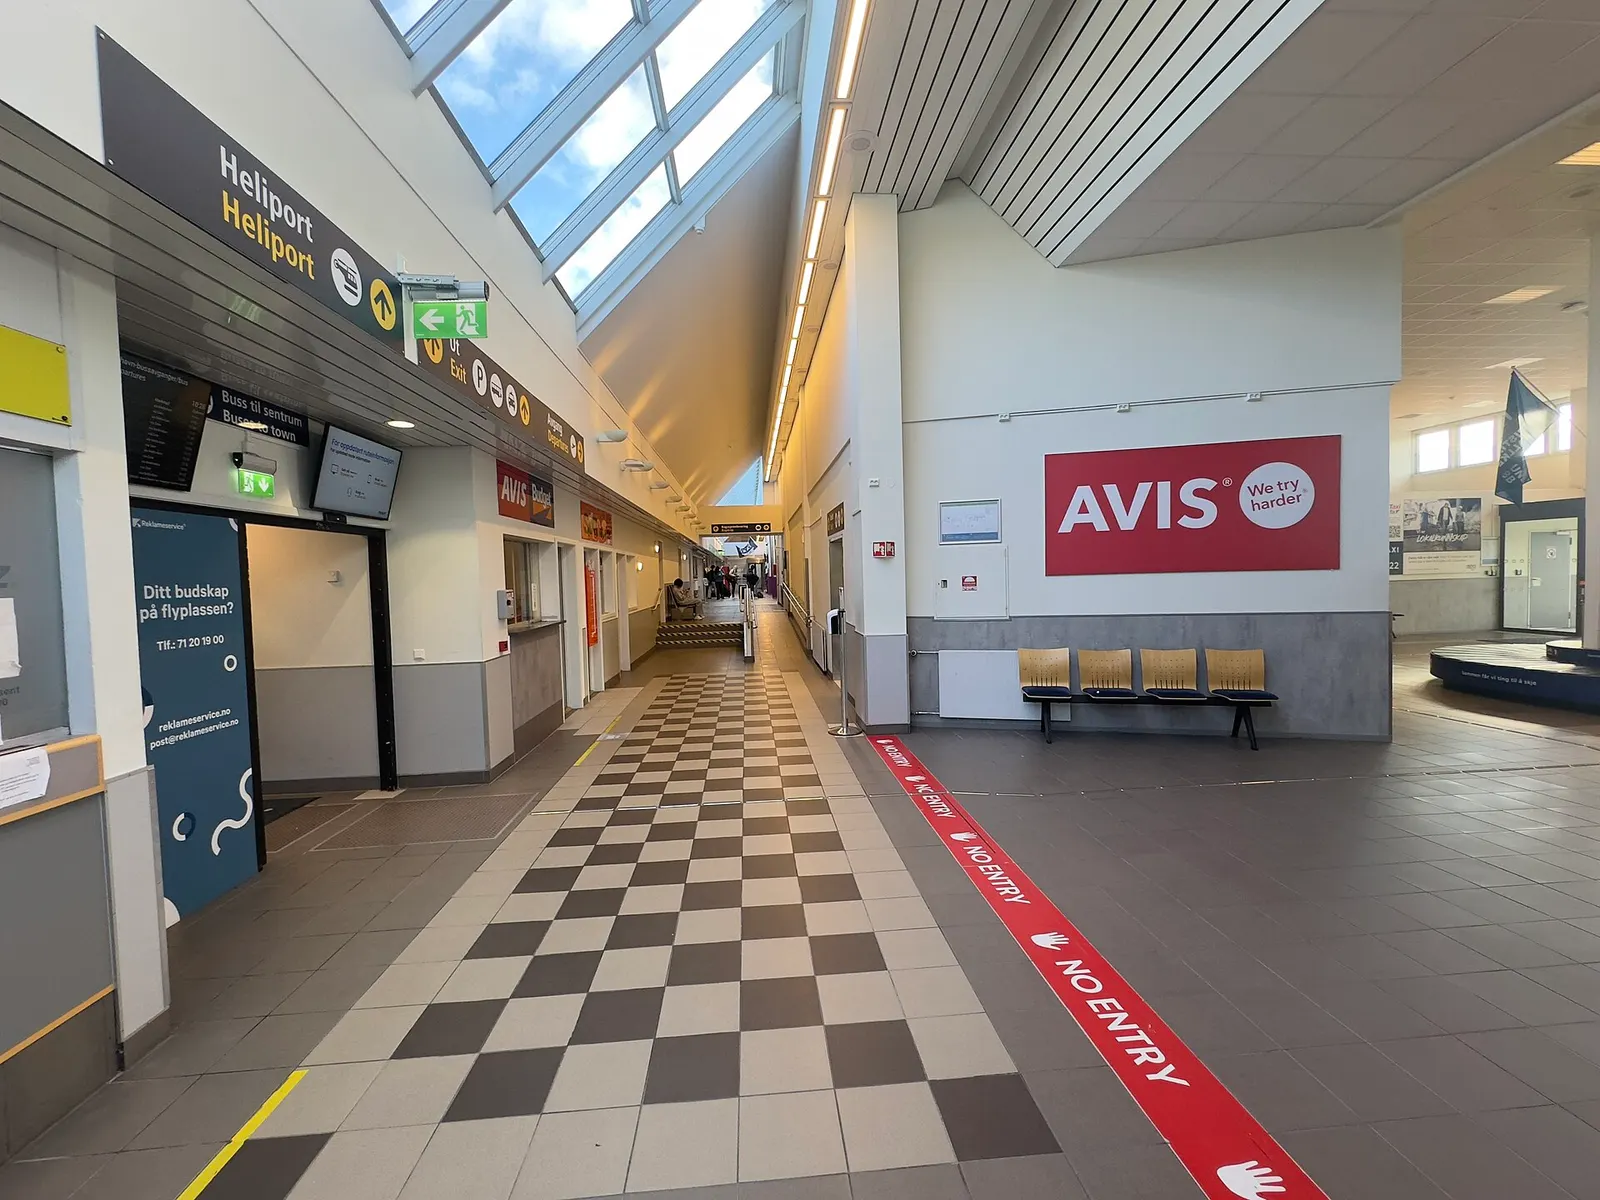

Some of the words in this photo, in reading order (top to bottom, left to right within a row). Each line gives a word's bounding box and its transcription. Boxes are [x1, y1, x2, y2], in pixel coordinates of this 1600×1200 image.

[220, 145, 313, 242] Heliport
[222, 190, 316, 281] Heliport
[450, 357, 467, 385] Exit
[222, 389, 247, 410] Buss
[250, 401, 261, 414] til
[263, 406, 303, 428] sentrum
[270, 425, 297, 442] town
[501, 475, 527, 508] AVIS
[532, 483, 553, 509] Budget
[1247, 482, 1273, 497] We
[1276, 478, 1300, 494] try
[1057, 477, 1218, 534] AVIS
[1250, 492, 1302, 512] harder
[141, 519, 185, 531] Reklameservice
[143, 584, 172, 601] Ditt
[174, 583, 229, 601] budskap
[139, 603, 158, 623] på
[161, 601, 235, 622] flyplassen?
[156, 639, 175, 652] Tlf.:
[177, 638, 187, 649] 71
[188, 637, 201, 648] 20
[202, 636, 212, 647] 19
[212, 634, 225, 645] 00
[1497, 675, 1510, 684] ting
[158, 706, 231, 733] reklameservice.no
[149, 717, 239, 750] post@reklameservice.no
[883, 744, 898, 754] NO
[890, 751, 912, 768] ENTRY
[922, 793, 956, 819] ENTRY
[963, 845, 993, 863] NO
[978, 864, 1031, 905] ENTRY
[1055, 959, 1104, 994] NO
[1086, 997, 1191, 1087] ENTRY
